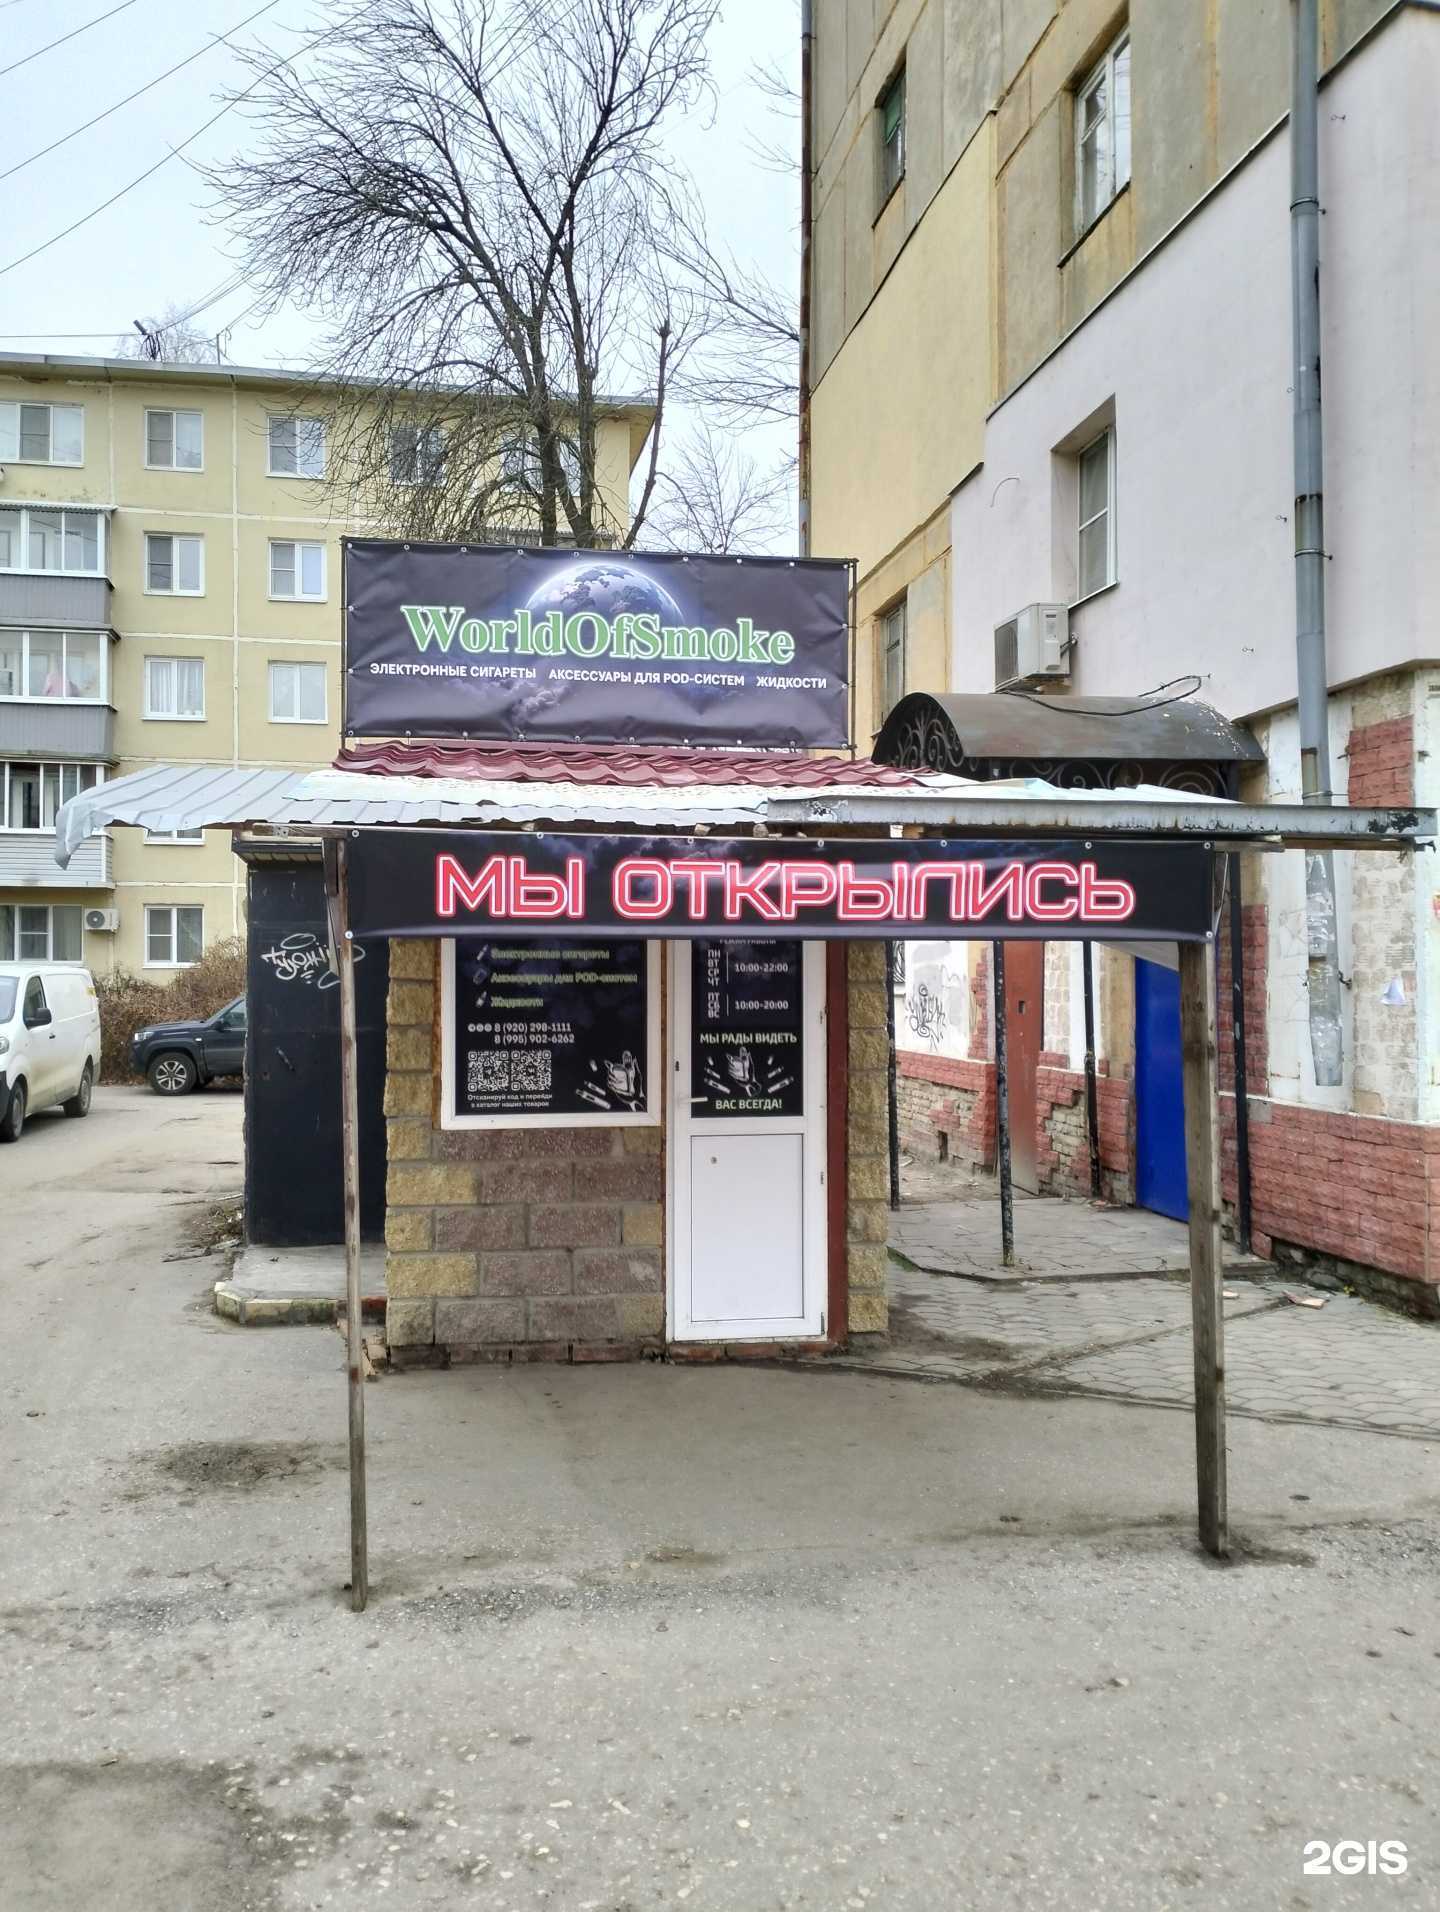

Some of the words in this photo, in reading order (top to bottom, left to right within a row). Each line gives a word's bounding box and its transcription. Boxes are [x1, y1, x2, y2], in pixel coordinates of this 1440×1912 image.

[400, 605, 796, 665] WorldOfSmoke
[369, 662, 468, 678] ЭЛЕКТРОННЫЕ
[470, 666, 537, 680] СИГАРЕТЫ
[548, 668, 632, 683] АКСЕССУАРЫ
[634, 671, 661, 686] ДЛЯ
[663, 672, 745, 687] POD-СИСТЕМ
[756, 675, 827, 690] ЖИДКОСТИ
[434, 854, 585, 918] МЫ
[611, 858, 1136, 921] ОТКРЫЛИСЬ
[735, 963, 789, 973] 10:00-22:00
[735, 1001, 789, 1011] 10:00-20:00
[494, 1023, 501, 1033] 8
[502, 1023, 528, 1034] (920)
[494, 1034, 501, 1044] 8
[502, 1034, 528, 1046] (995)
[529, 1034, 575, 1044] 902-6262
[700, 1033, 720, 1044] МЫ
[721, 1033, 753, 1044] РАДЫ
[755, 1033, 797, 1043] ВИДЕТЬ
[715, 1099, 737, 1109] ВАС
[738, 1099, 782, 1110] ВСЕГДА!
